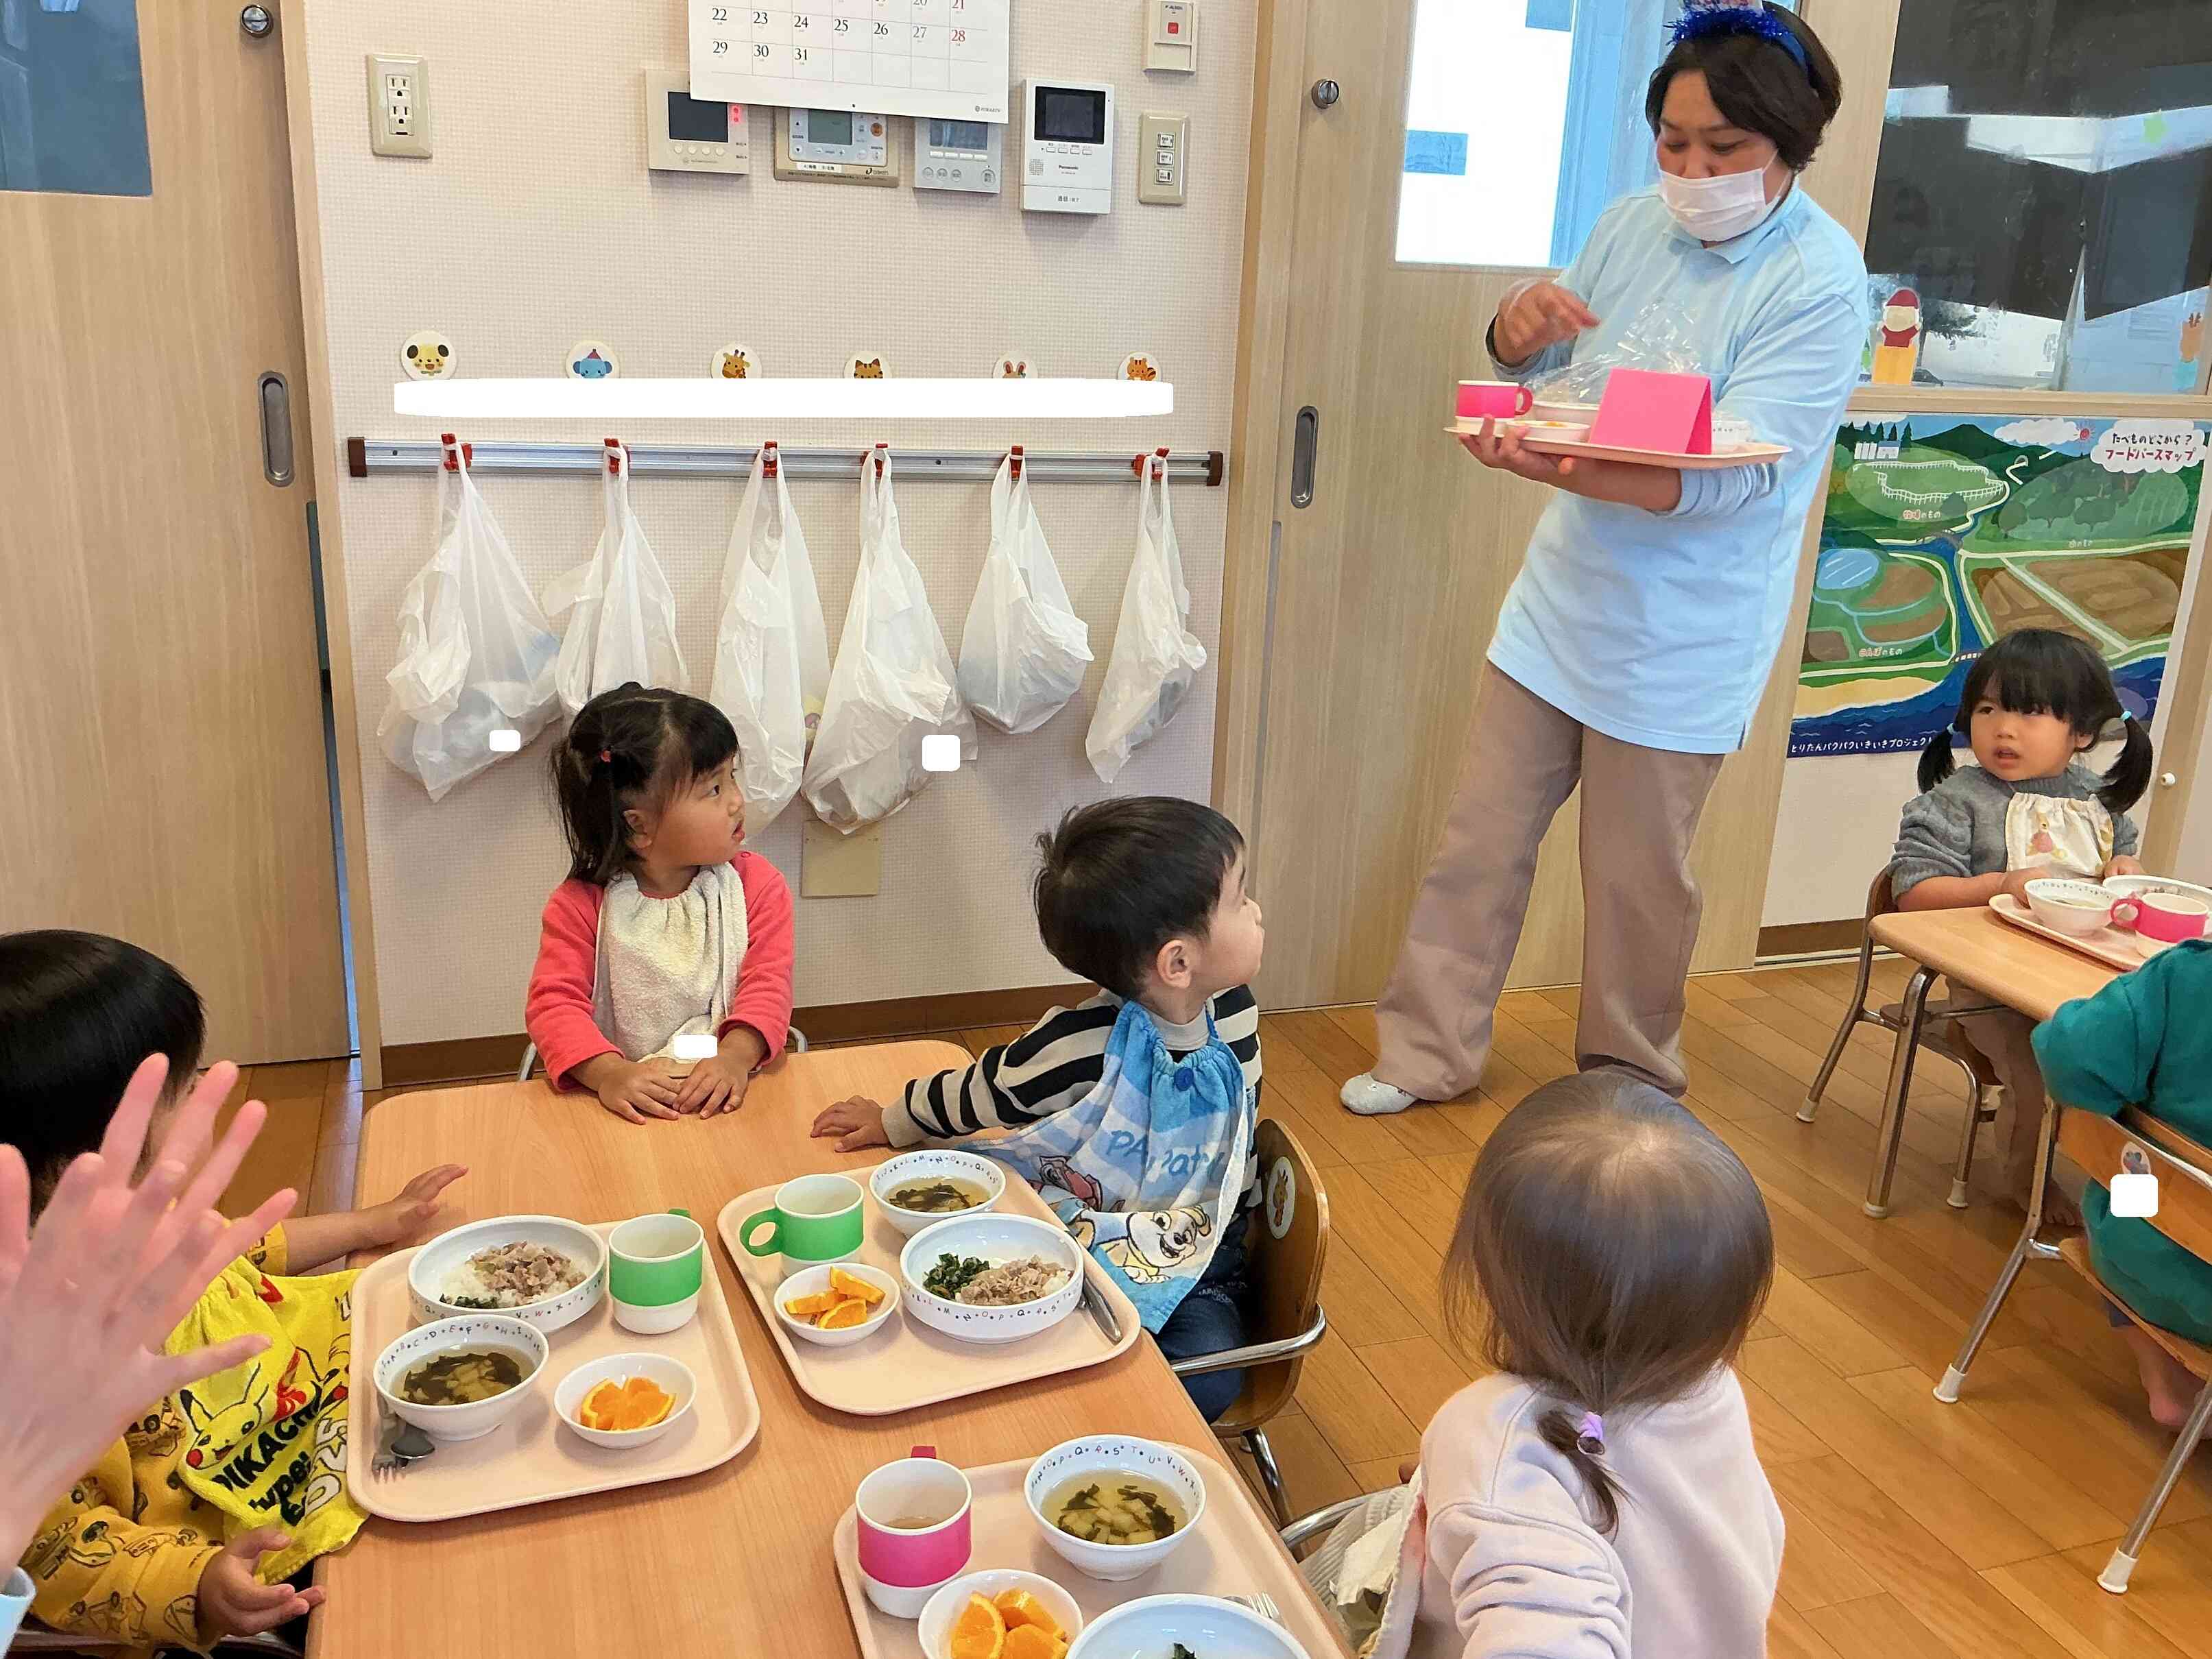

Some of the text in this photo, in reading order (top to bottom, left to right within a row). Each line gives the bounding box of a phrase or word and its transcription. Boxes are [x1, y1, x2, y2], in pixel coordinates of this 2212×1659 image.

[712, 8, 966, 43] 22 23 24 25 26 27 28
[712, 40, 808, 61] 29 30 31
[2106, 446, 2198, 462] フードバースマップ
[1106, 1130, 1149, 1157] PA
[466, 1326, 472, 1334] F
[1075, 1446, 1084, 1455] Q
[1113, 1446, 1120, 1455] S
[1149, 1455, 1155, 1464] U
[1168, 1455, 1173, 1464] V
